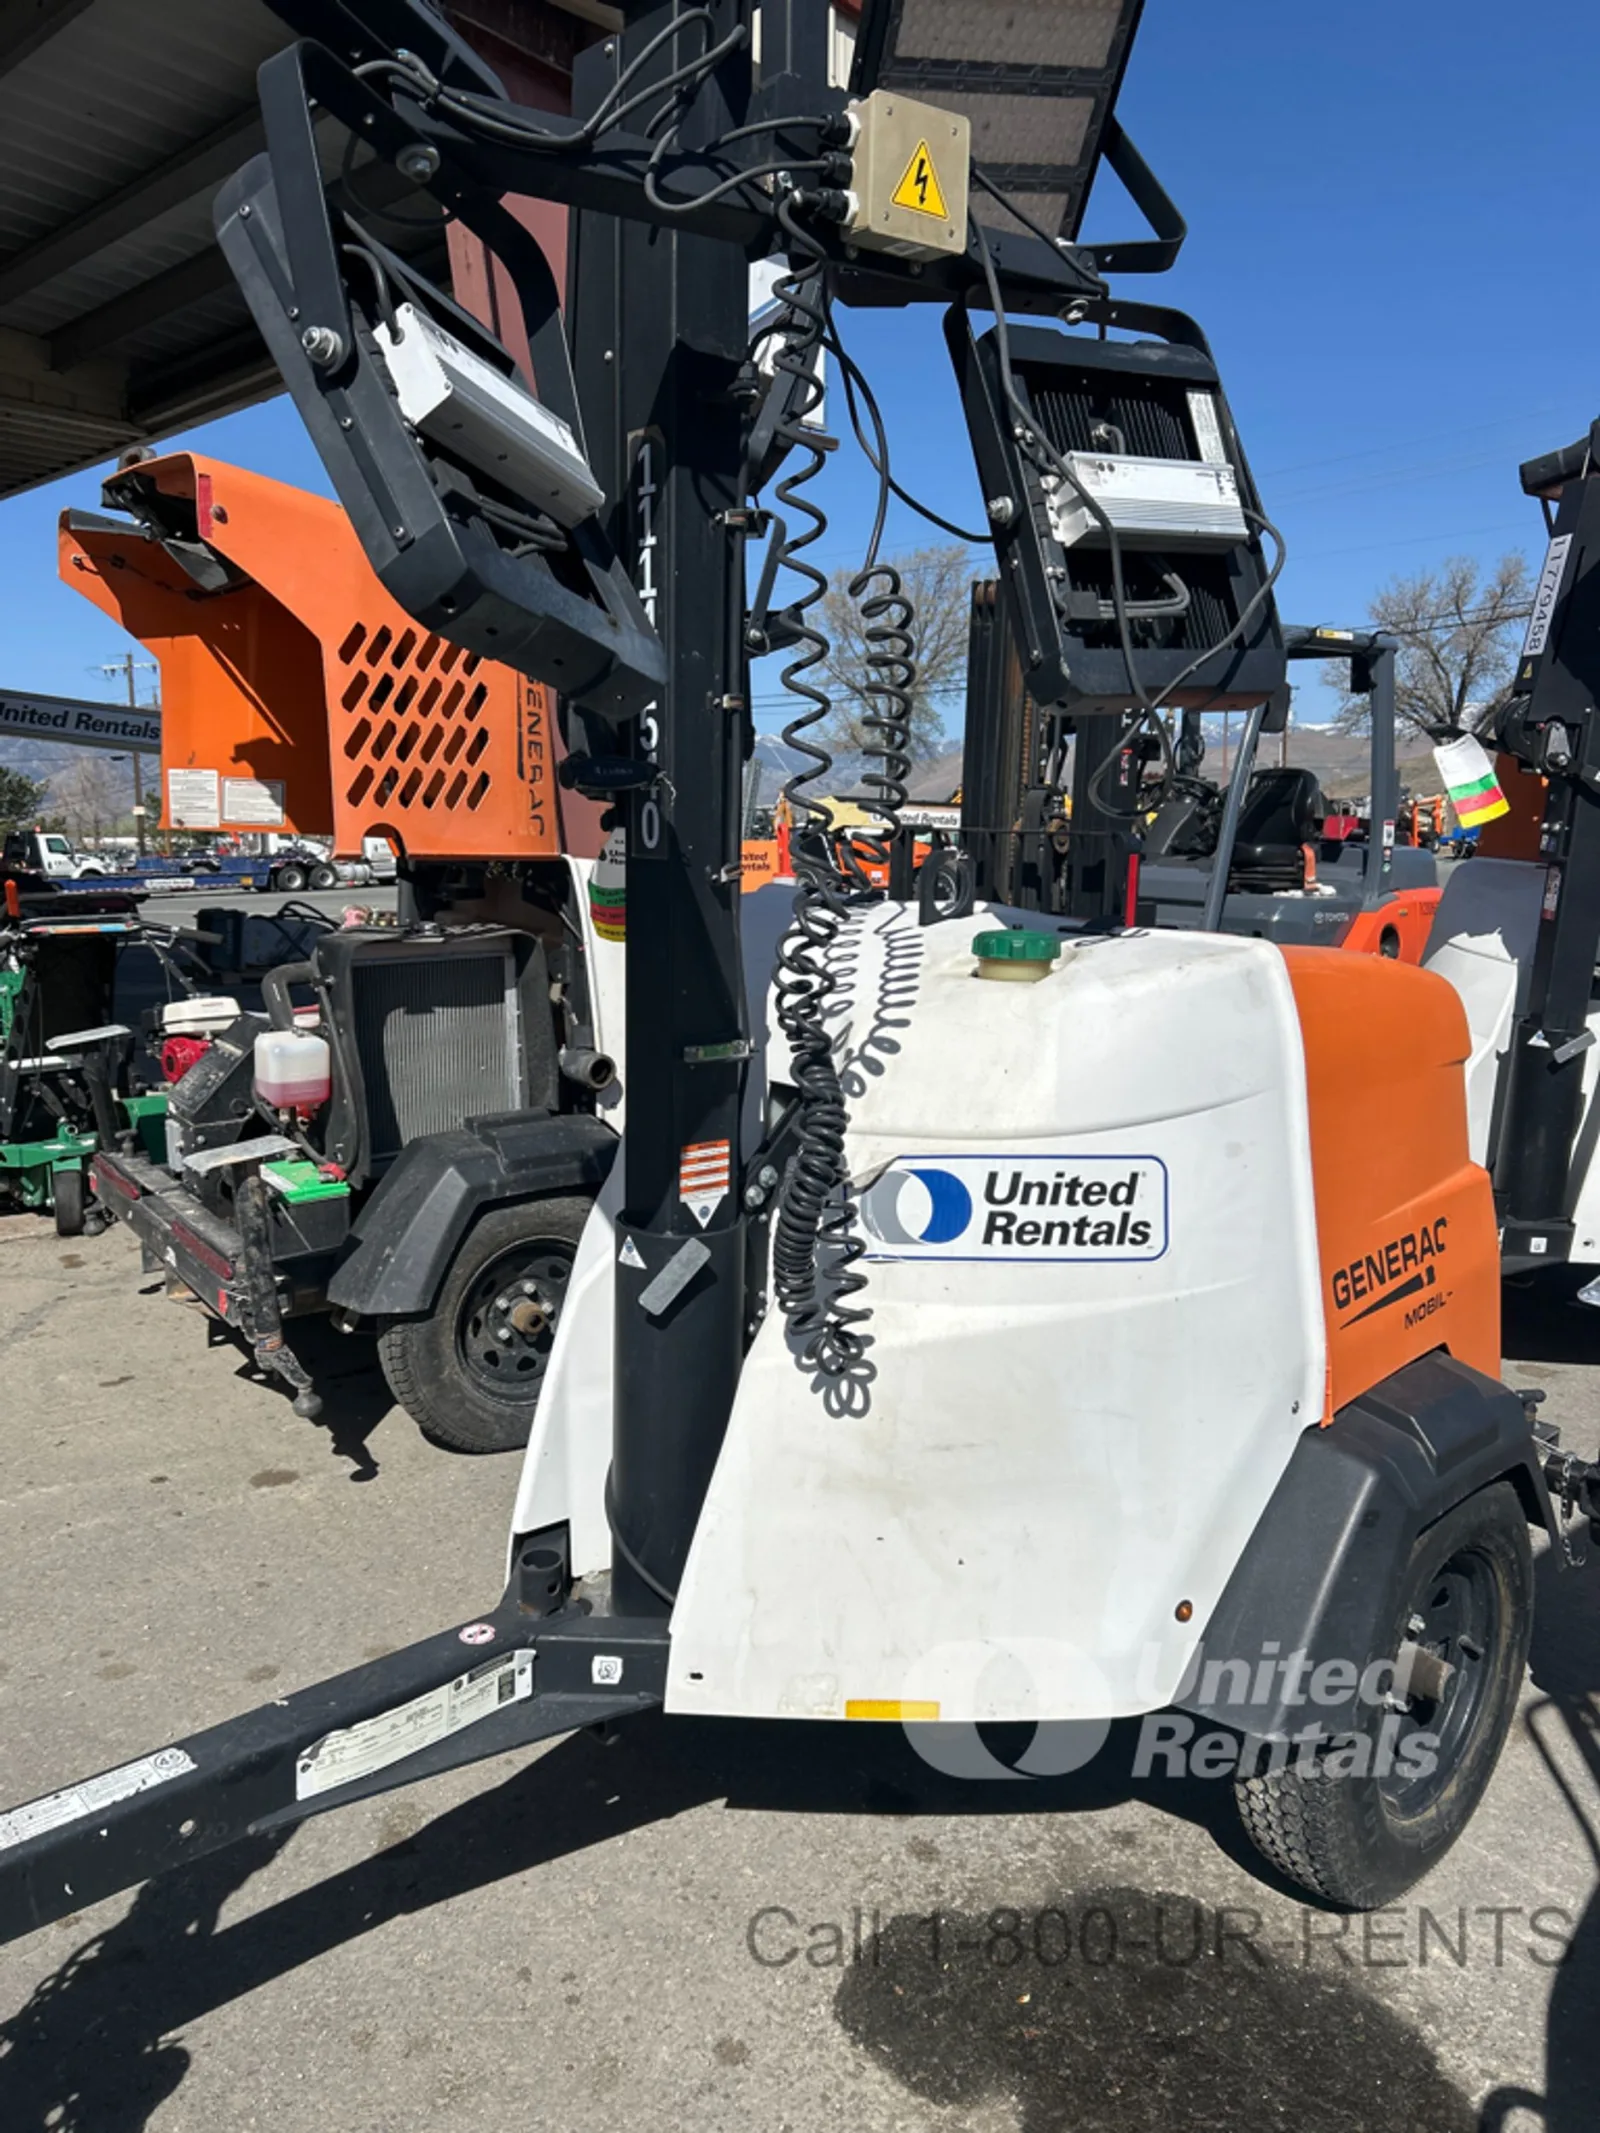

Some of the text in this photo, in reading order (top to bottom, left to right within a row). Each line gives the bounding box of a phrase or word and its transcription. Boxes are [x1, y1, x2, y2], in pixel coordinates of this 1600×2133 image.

[0, 703, 160, 739] nited Rentals
[983, 1170, 1140, 1207] United
[982, 1211, 1152, 1247] Rentals
[1332, 1216, 1448, 1311] GENERAC
